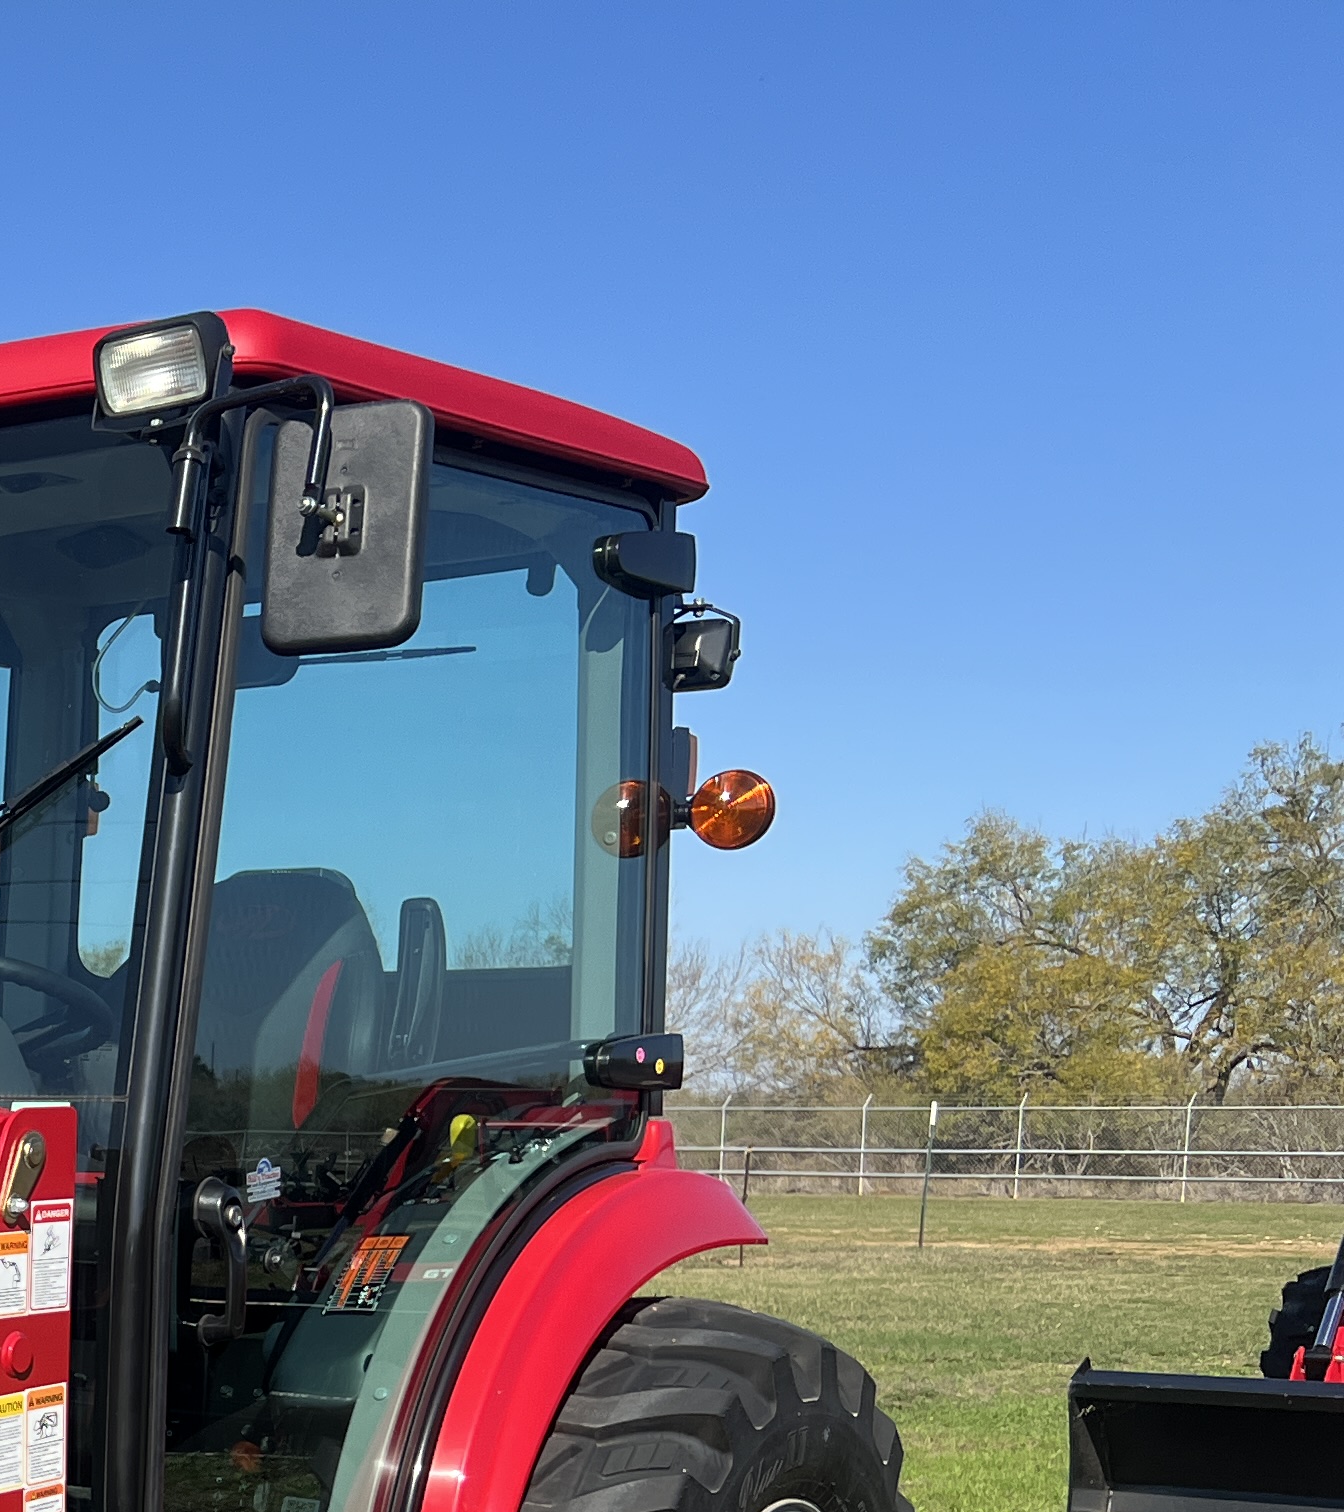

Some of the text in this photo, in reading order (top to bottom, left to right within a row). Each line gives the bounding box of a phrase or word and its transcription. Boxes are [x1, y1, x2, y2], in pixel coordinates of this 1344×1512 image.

[41, 1208, 69, 1219] DANGER
[0, 1240, 28, 1251] WARNING
[35, 1392, 64, 1406] WARNING
